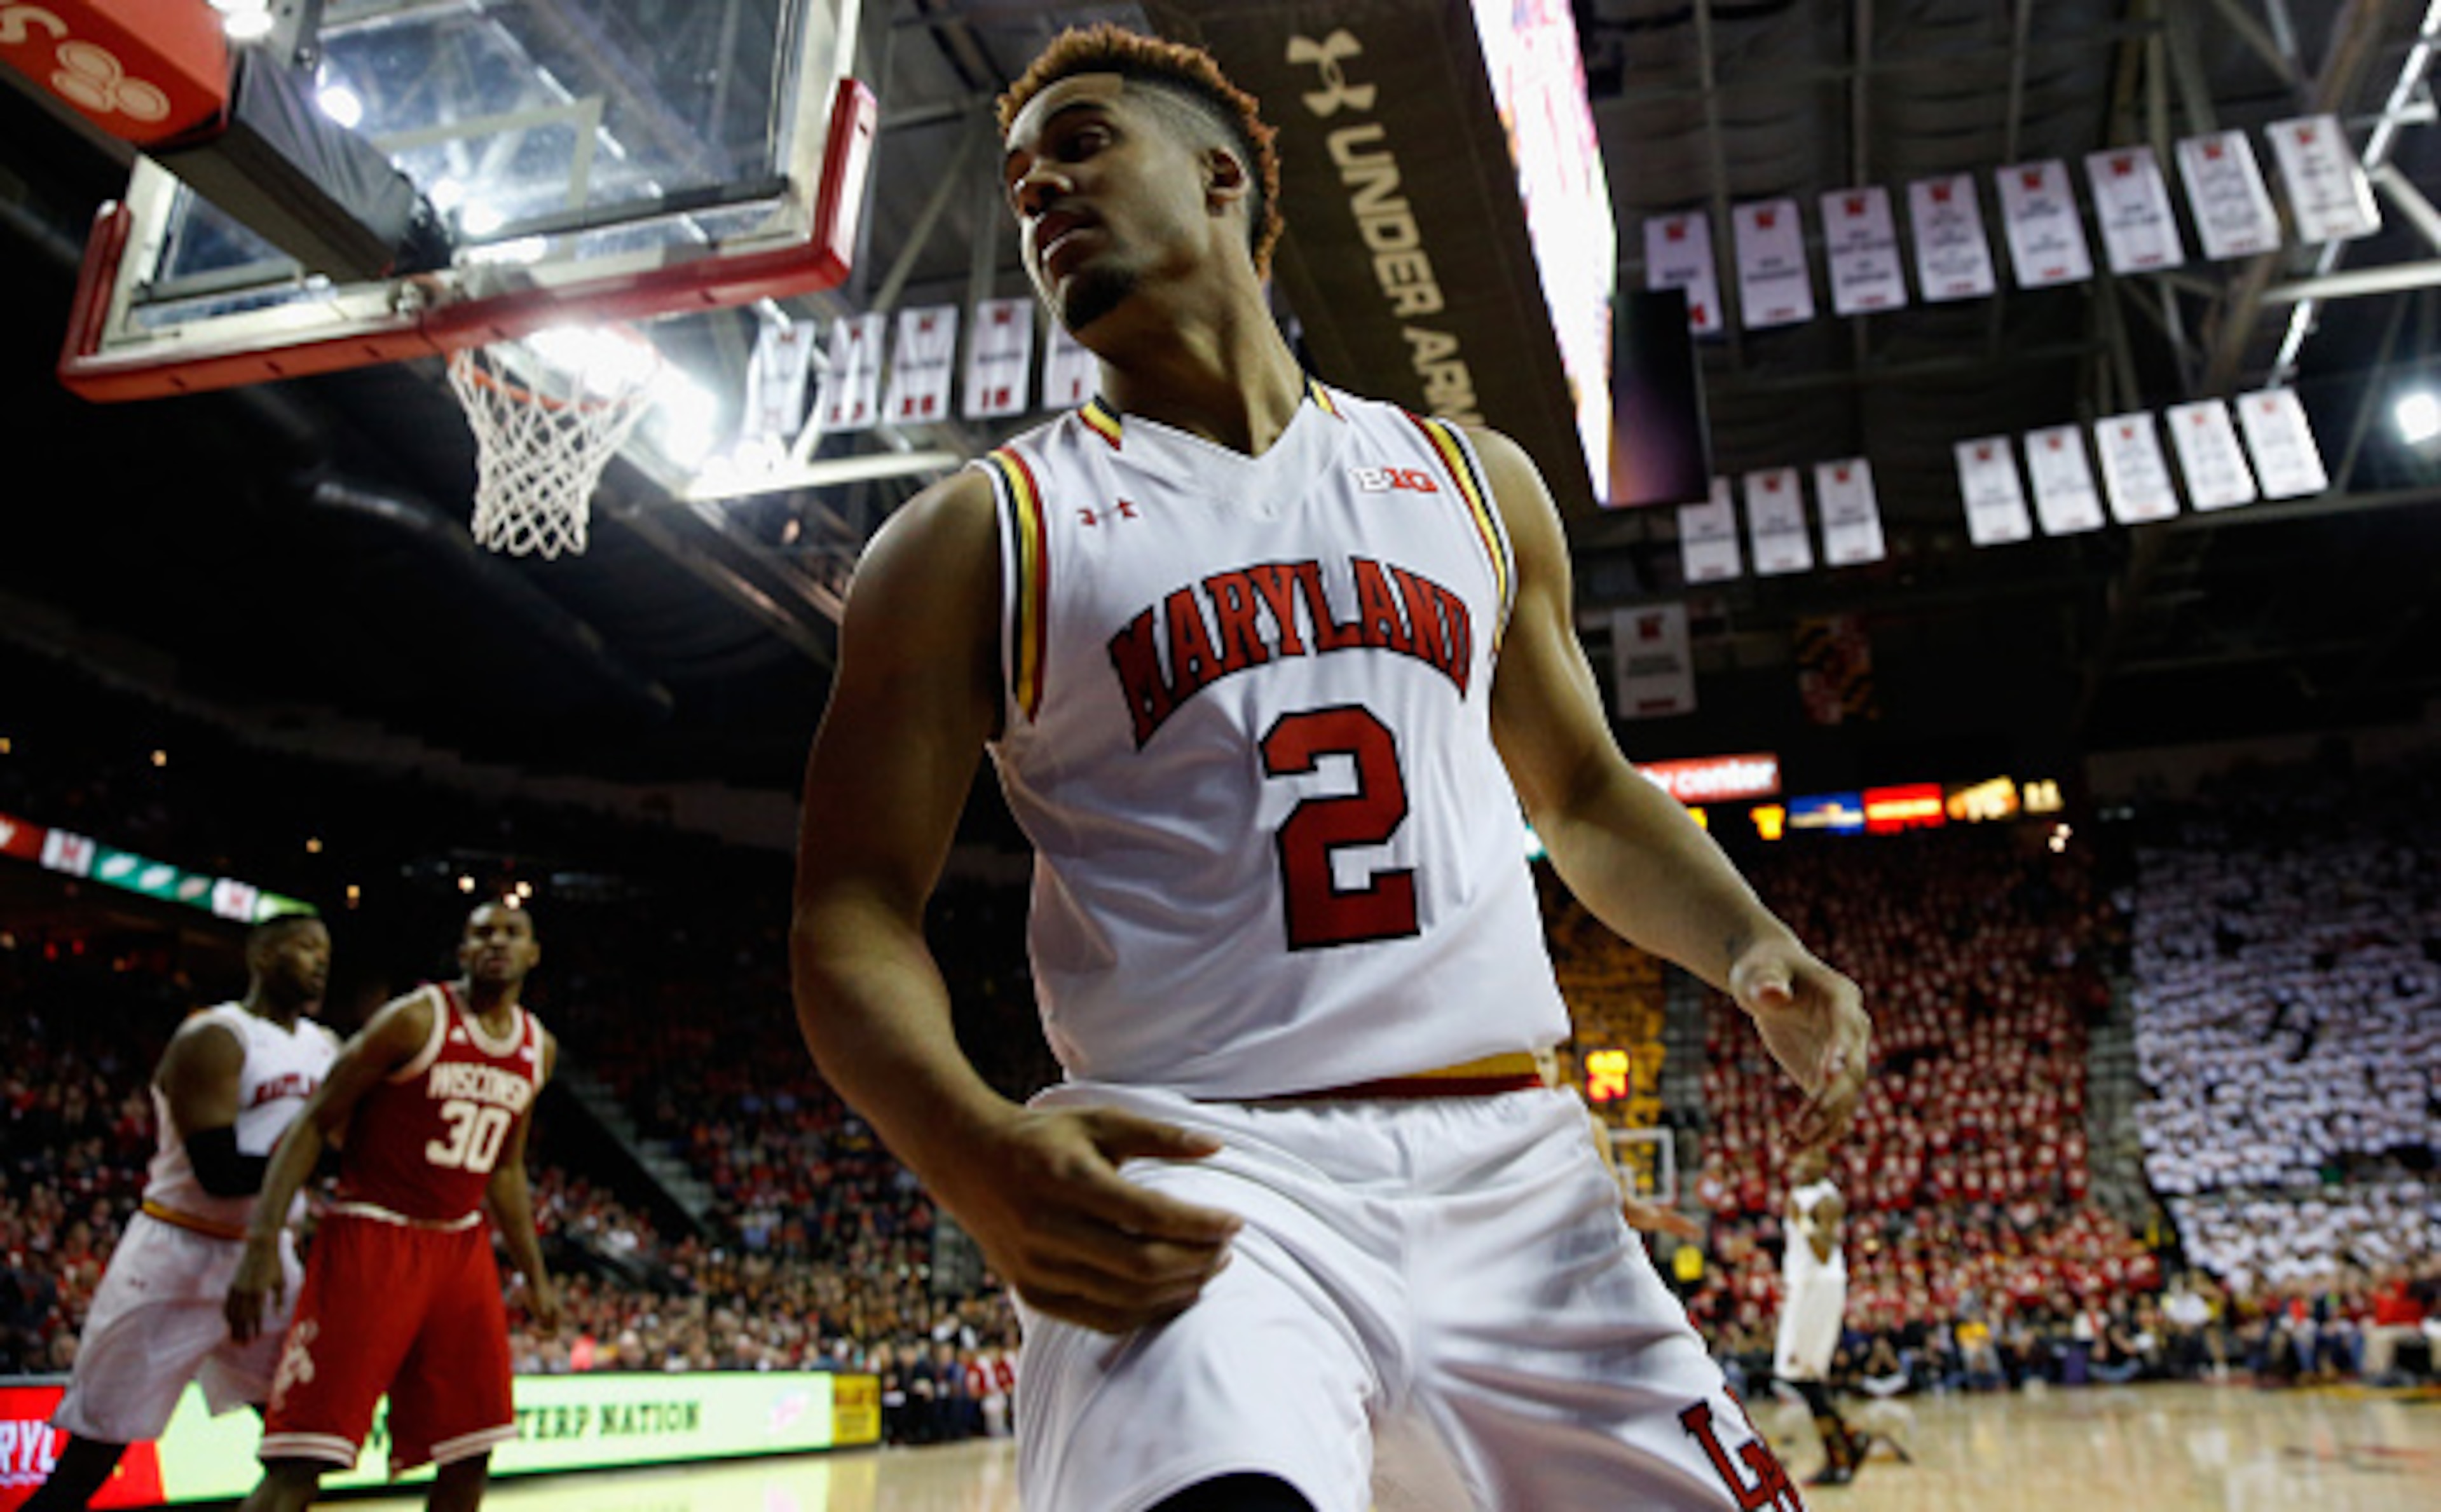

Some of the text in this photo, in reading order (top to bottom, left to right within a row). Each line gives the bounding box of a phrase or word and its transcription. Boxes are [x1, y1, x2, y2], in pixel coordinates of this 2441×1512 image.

[1327, 123, 1485, 428] UNDER ARM
[1106, 555, 1472, 753] MARYLAND
[1258, 703, 1421, 953] 2
[425, 1100, 512, 1173] 30
[515, 1400, 700, 1440] TERP NATION
